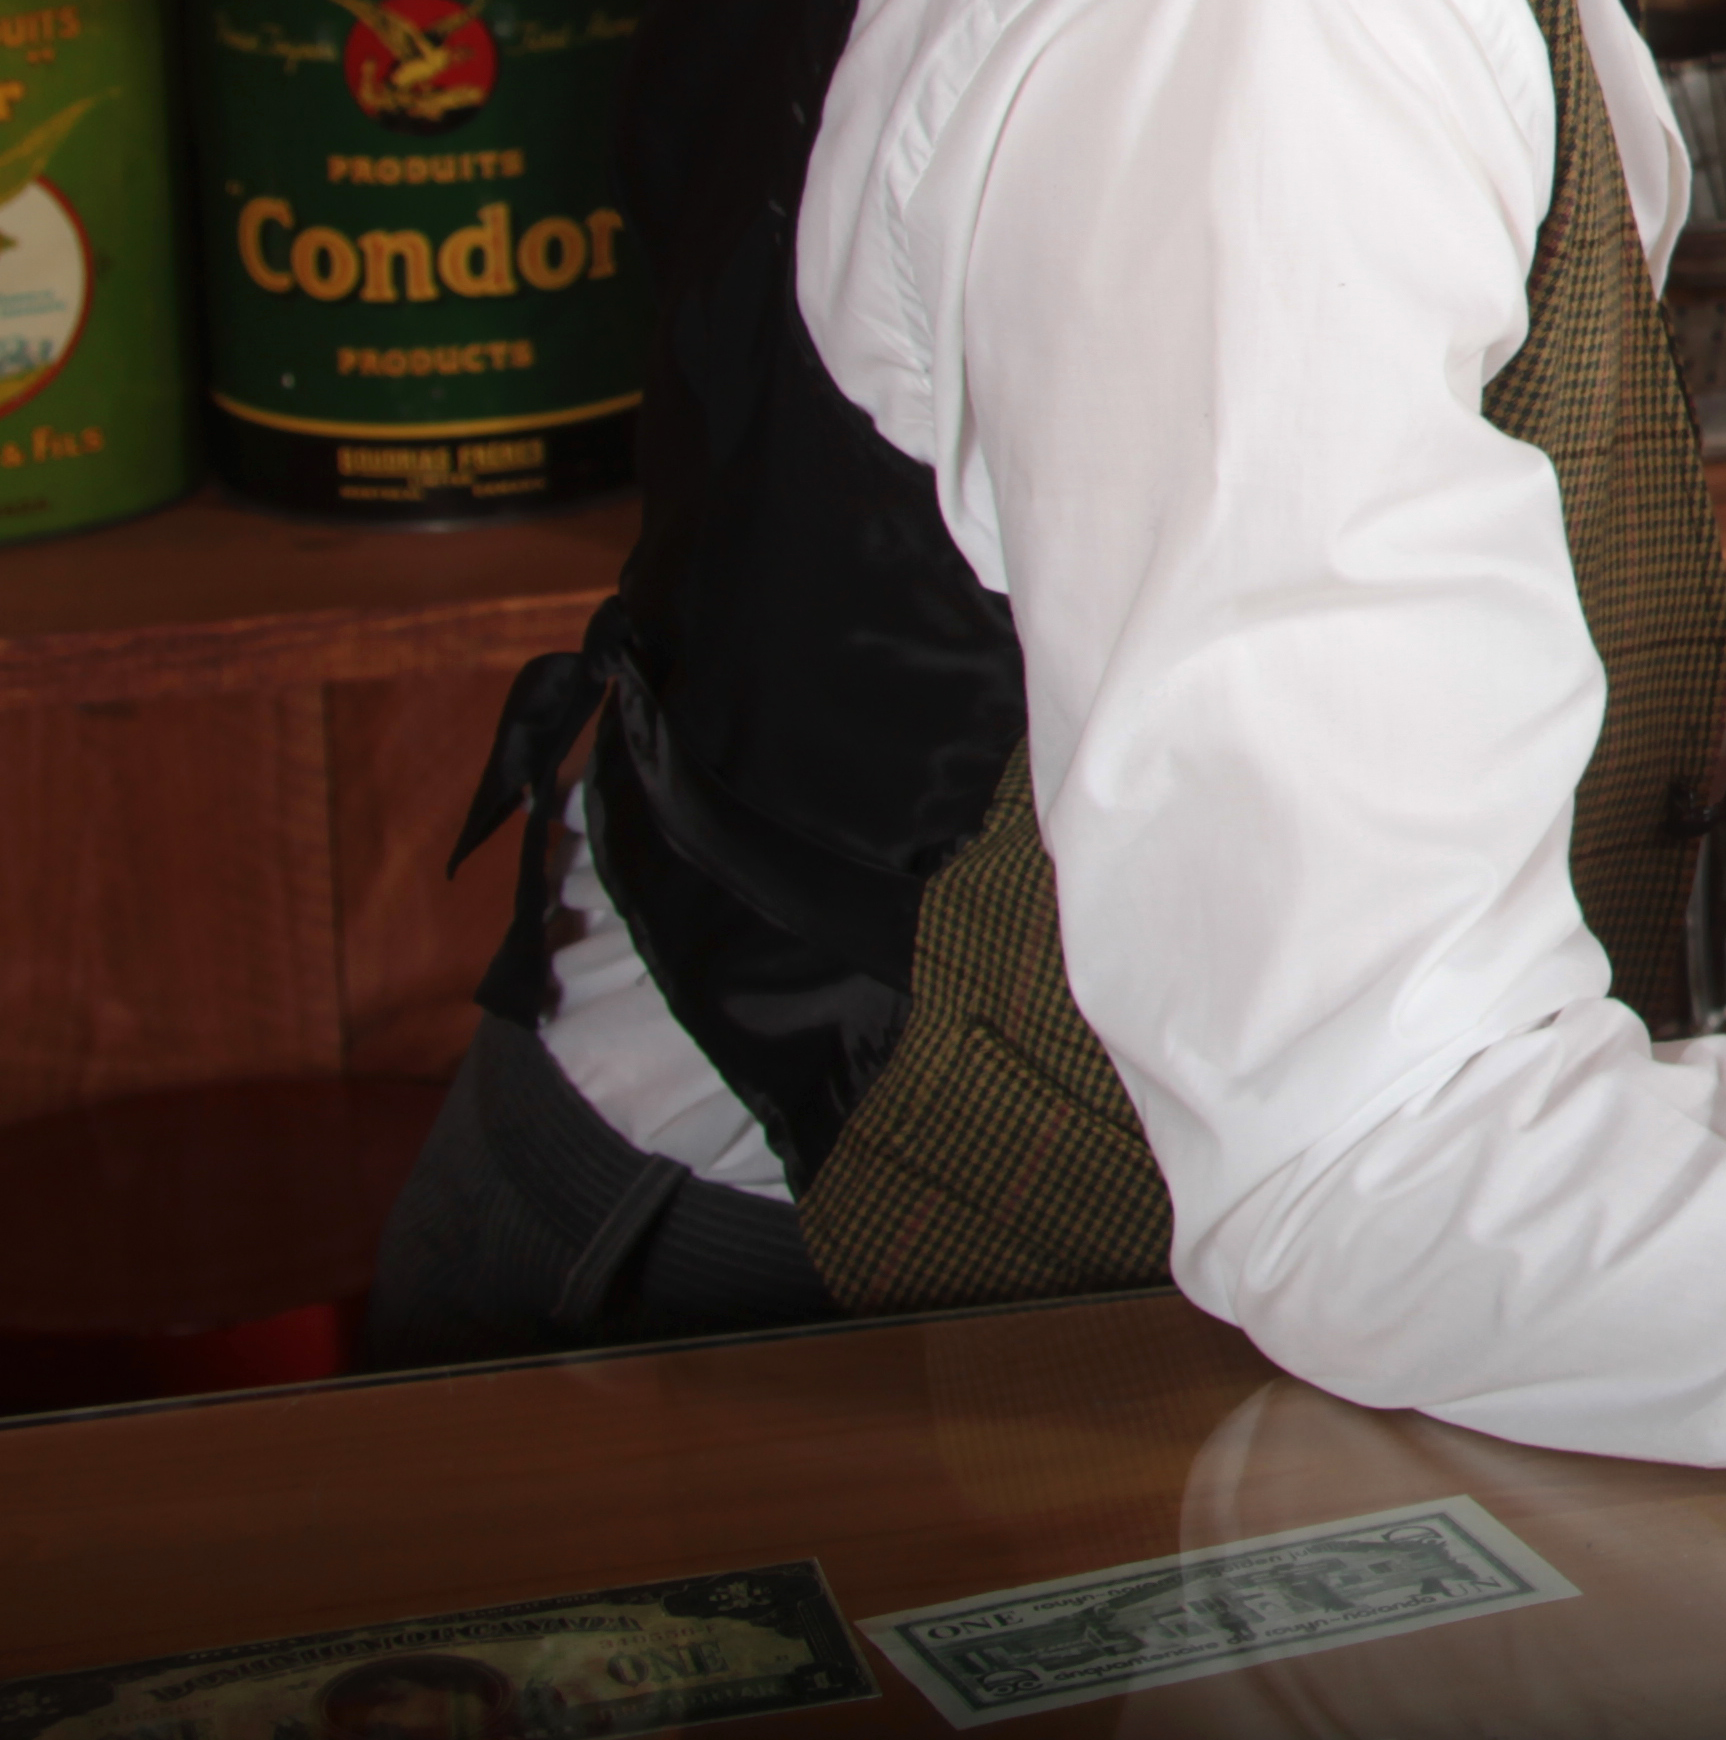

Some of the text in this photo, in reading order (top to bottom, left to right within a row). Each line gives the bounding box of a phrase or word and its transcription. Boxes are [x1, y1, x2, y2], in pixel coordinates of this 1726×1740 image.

[328, 149, 525, 185] PRODUITS
[237, 201, 624, 304] Condor
[337, 339, 535, 378] PRODUCTS
[927, 1609, 1024, 1641] ONE
[607, 1639, 730, 1688] ONE
